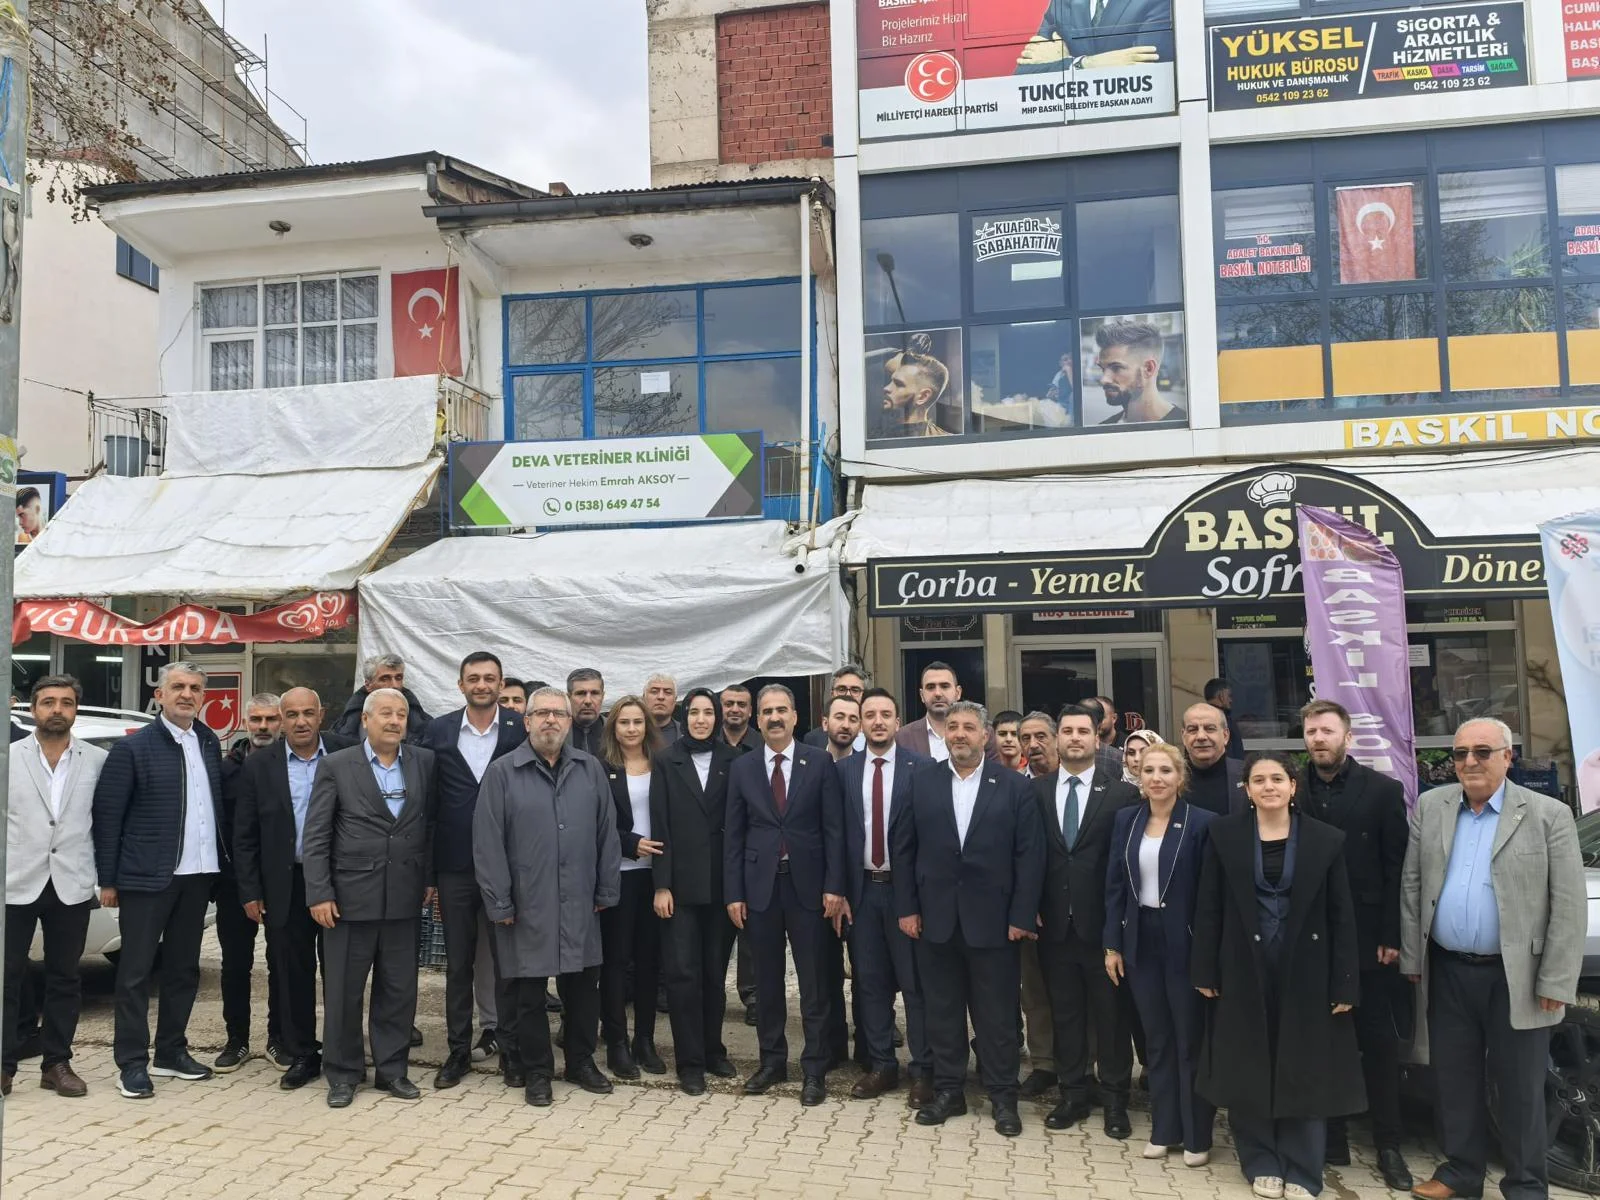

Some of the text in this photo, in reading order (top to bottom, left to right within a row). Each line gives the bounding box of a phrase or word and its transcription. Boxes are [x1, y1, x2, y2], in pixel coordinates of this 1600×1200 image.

[881, 12, 968, 31] Projelerimiz Hazır
[1486, 12, 1501, 26] &
[882, 32, 934, 47] Biz Hazırız
[1221, 26, 1364, 58] YÜKSEL
[1403, 27, 1497, 49] ARACILIK
[1570, 37, 1600, 51] BAS
[1227, 56, 1359, 81] HUKUK BÜROSU
[1406, 69, 1428, 77] KASKO
[1461, 63, 1485, 73] TARSİM
[1018, 75, 1153, 103] TUNCER TURUS
[1237, 74, 1349, 91] HUKUK VE DANIŞMANLIK
[1413, 76, 1491, 91] 0542 109 23 62
[1256, 88, 1329, 103] 0542 109 23 62
[876, 101, 998, 123] MİLLİYETÇİ HAREKET PARTİSİ
[1021, 96, 1153, 115] MHP BASKİL BELEDİYE BAŞKAN ADAYI
[995, 219, 1039, 234] KUAFÖR
[978, 235, 1058, 256] SABAHATTİN
[1227, 248, 1258, 259] ADALET
[1220, 260, 1256, 278] BASKİL
[512, 446, 690, 468] DEVA VETERİNER KLİNİĞİ
[526, 473, 676, 489] Veteriner Hekim Emrah AKSOY
[565, 498, 660, 513] 0 (538) 649 47 54
[1184, 505, 1394, 552] BASL
[1442, 553, 1548, 583] Döne
[898, 569, 998, 605] Çorba
[1030, 563, 1145, 595] Yemek
[142, 611, 240, 642] GIDA
